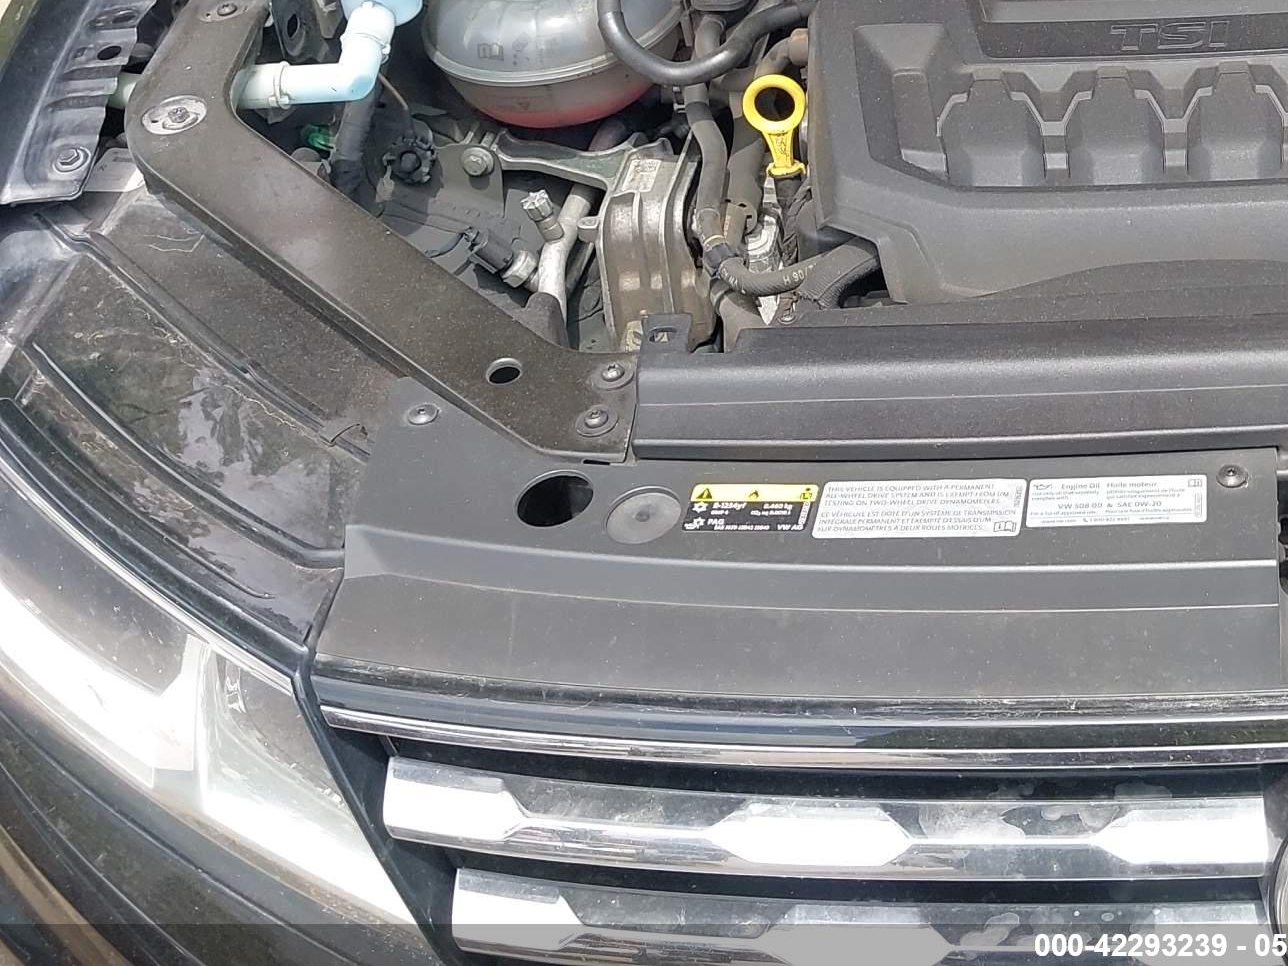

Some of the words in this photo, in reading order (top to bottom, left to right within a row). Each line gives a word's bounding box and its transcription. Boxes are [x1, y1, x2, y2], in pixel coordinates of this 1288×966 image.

[1110, 20, 1230, 51] TSI
[783, 275, 790, 285] H
[885, 484, 922, 492] EQUIPPED
[1061, 482, 1088, 491] Engine
[857, 517, 900, 525] PERMANENT
